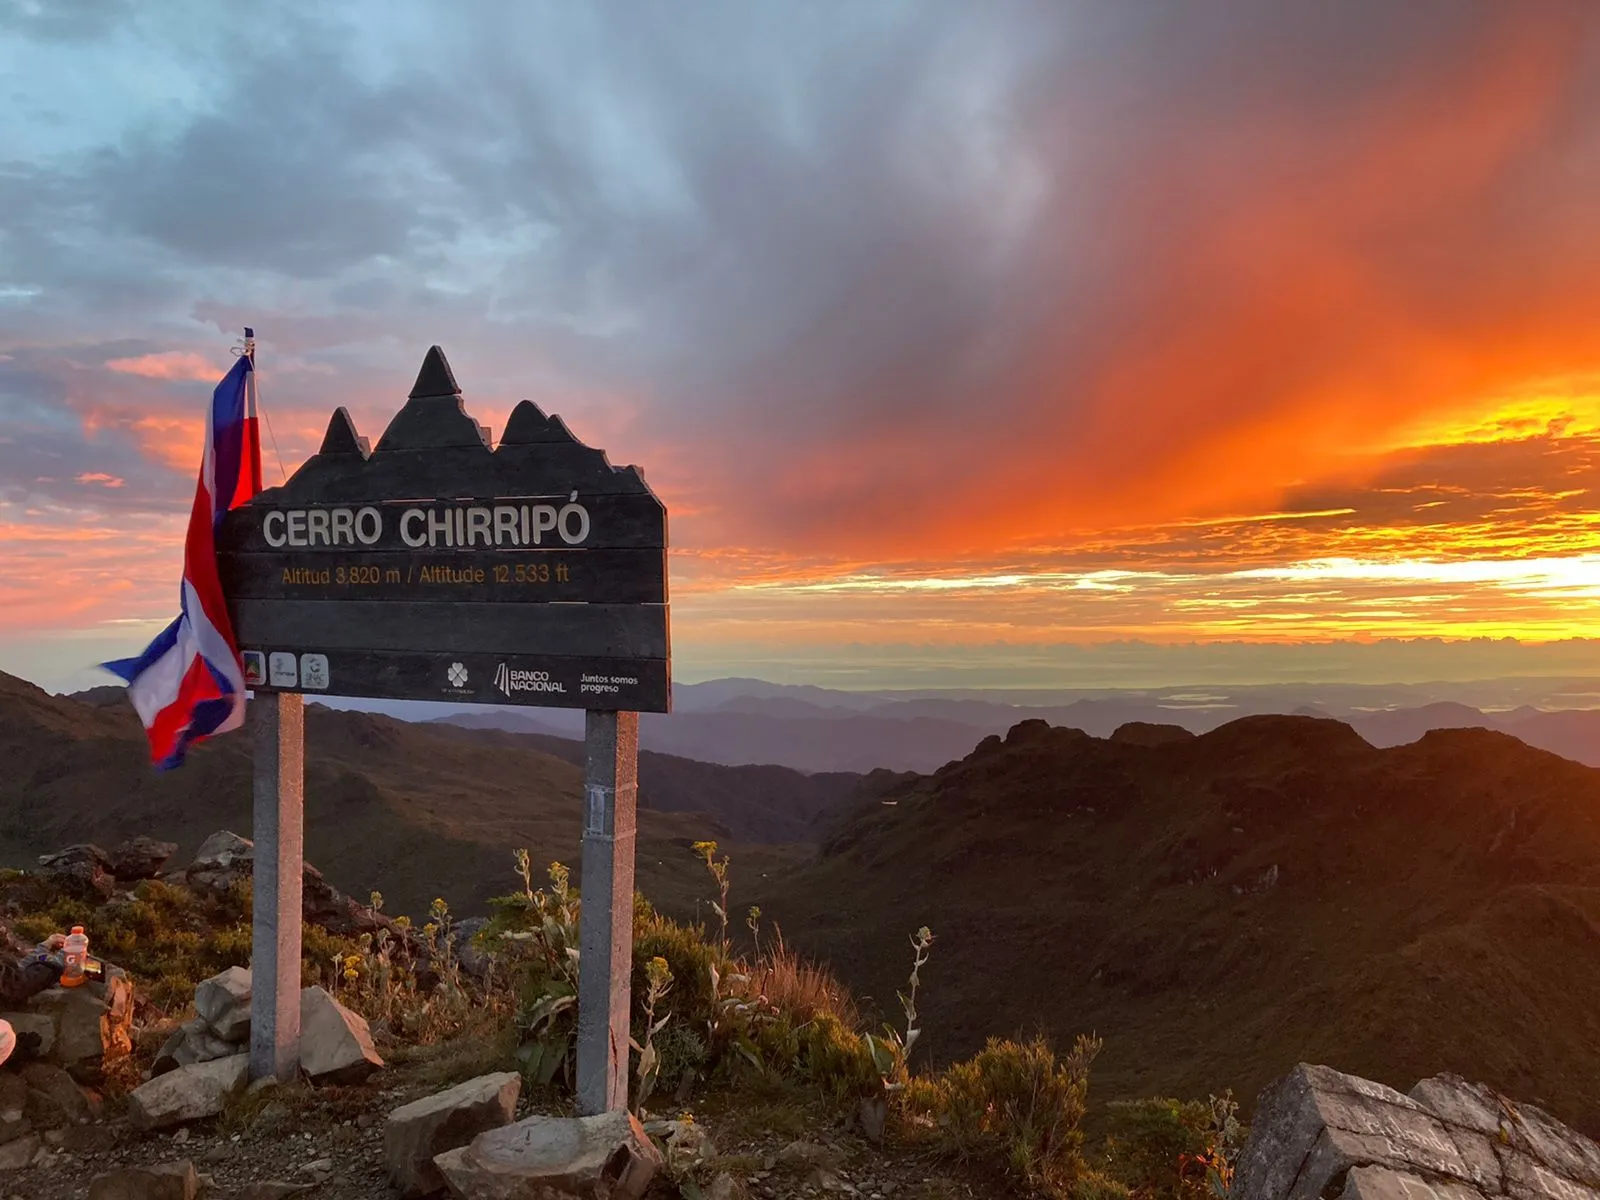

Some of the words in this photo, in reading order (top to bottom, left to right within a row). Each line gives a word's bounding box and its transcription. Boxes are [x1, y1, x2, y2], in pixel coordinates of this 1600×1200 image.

[263, 506, 383, 547] CERRO
[400, 490, 591, 547] CHIRRIPÓ
[282, 567, 330, 585] Altitud
[386, 569, 400, 584] m
[407, 566, 413, 584] /
[419, 565, 485, 583] Altitude
[556, 564, 569, 582] ft
[510, 670, 549, 681] BANCO
[580, 673, 608, 683] Juntos
[610, 675, 638, 685] somos
[510, 680, 567, 693] NACIONAL
[580, 683, 619, 694] progreso
